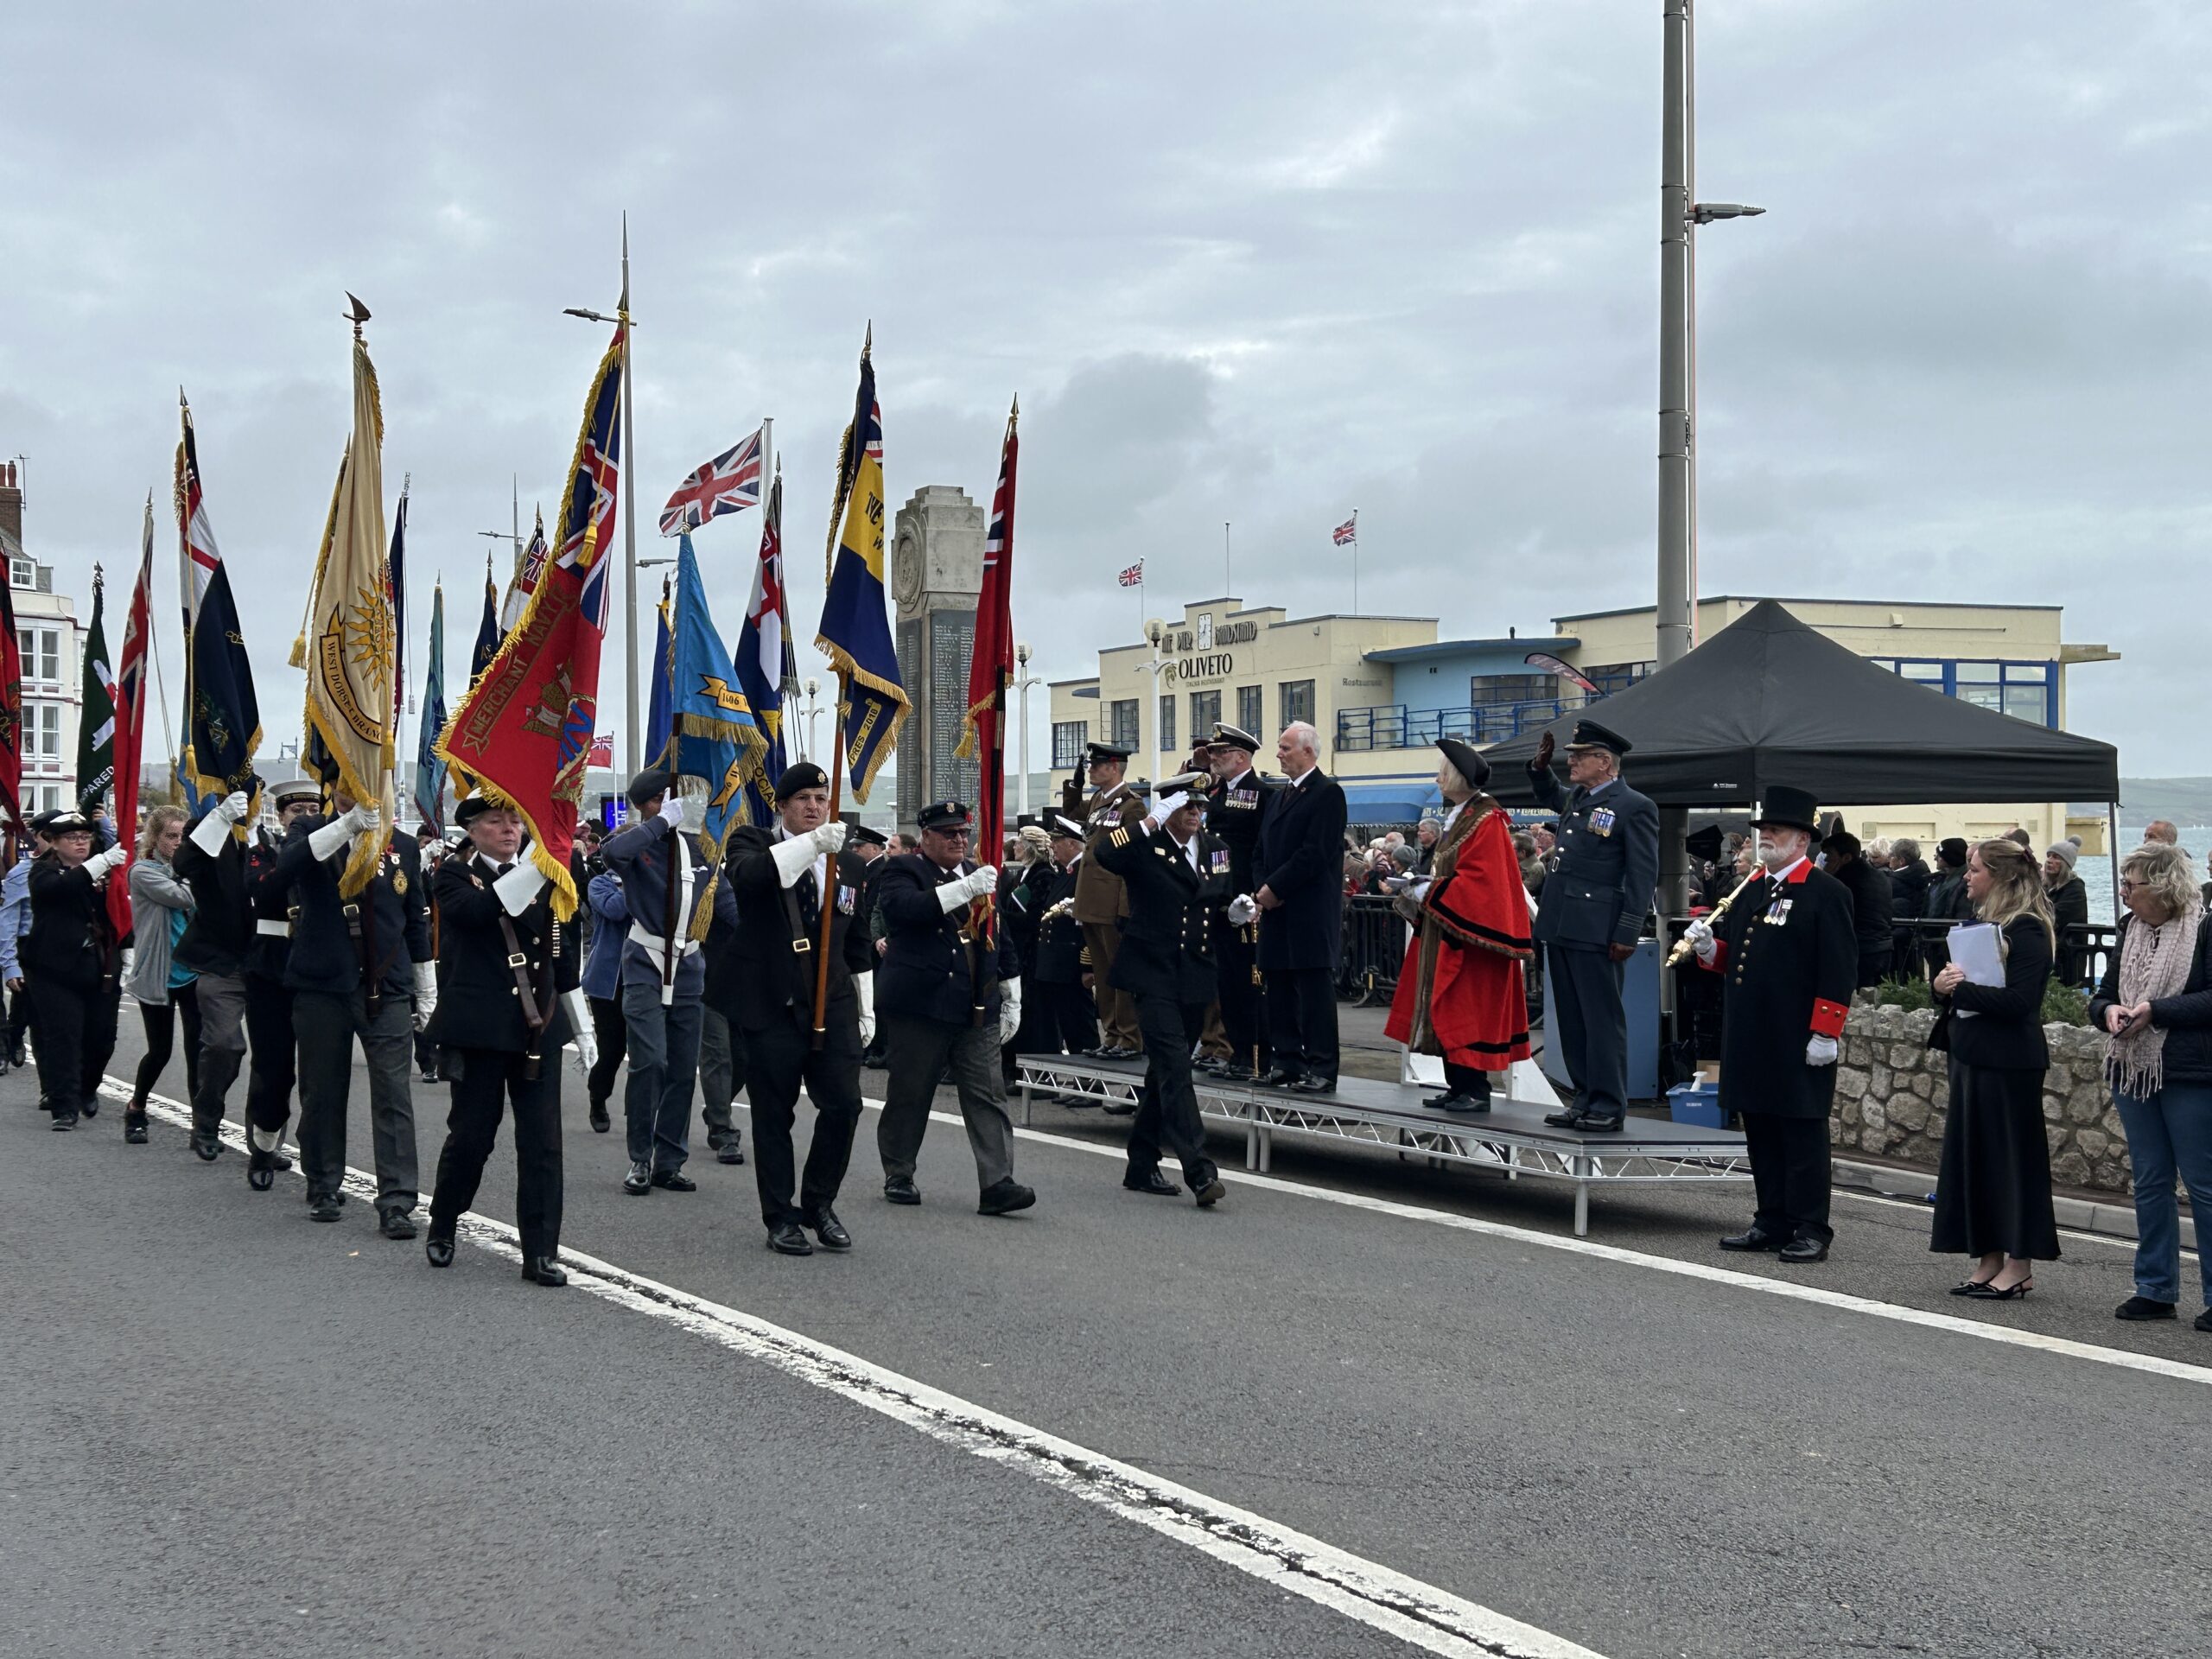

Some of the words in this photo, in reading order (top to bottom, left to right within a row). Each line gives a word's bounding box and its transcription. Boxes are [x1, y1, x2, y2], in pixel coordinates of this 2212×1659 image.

[327, 641, 339, 671] WEST
[471, 654, 528, 734] MERCHANT
[525, 598, 557, 646] NAVY
[1179, 653, 1232, 678] OLIVETO
[331, 673, 354, 714] DORSET
